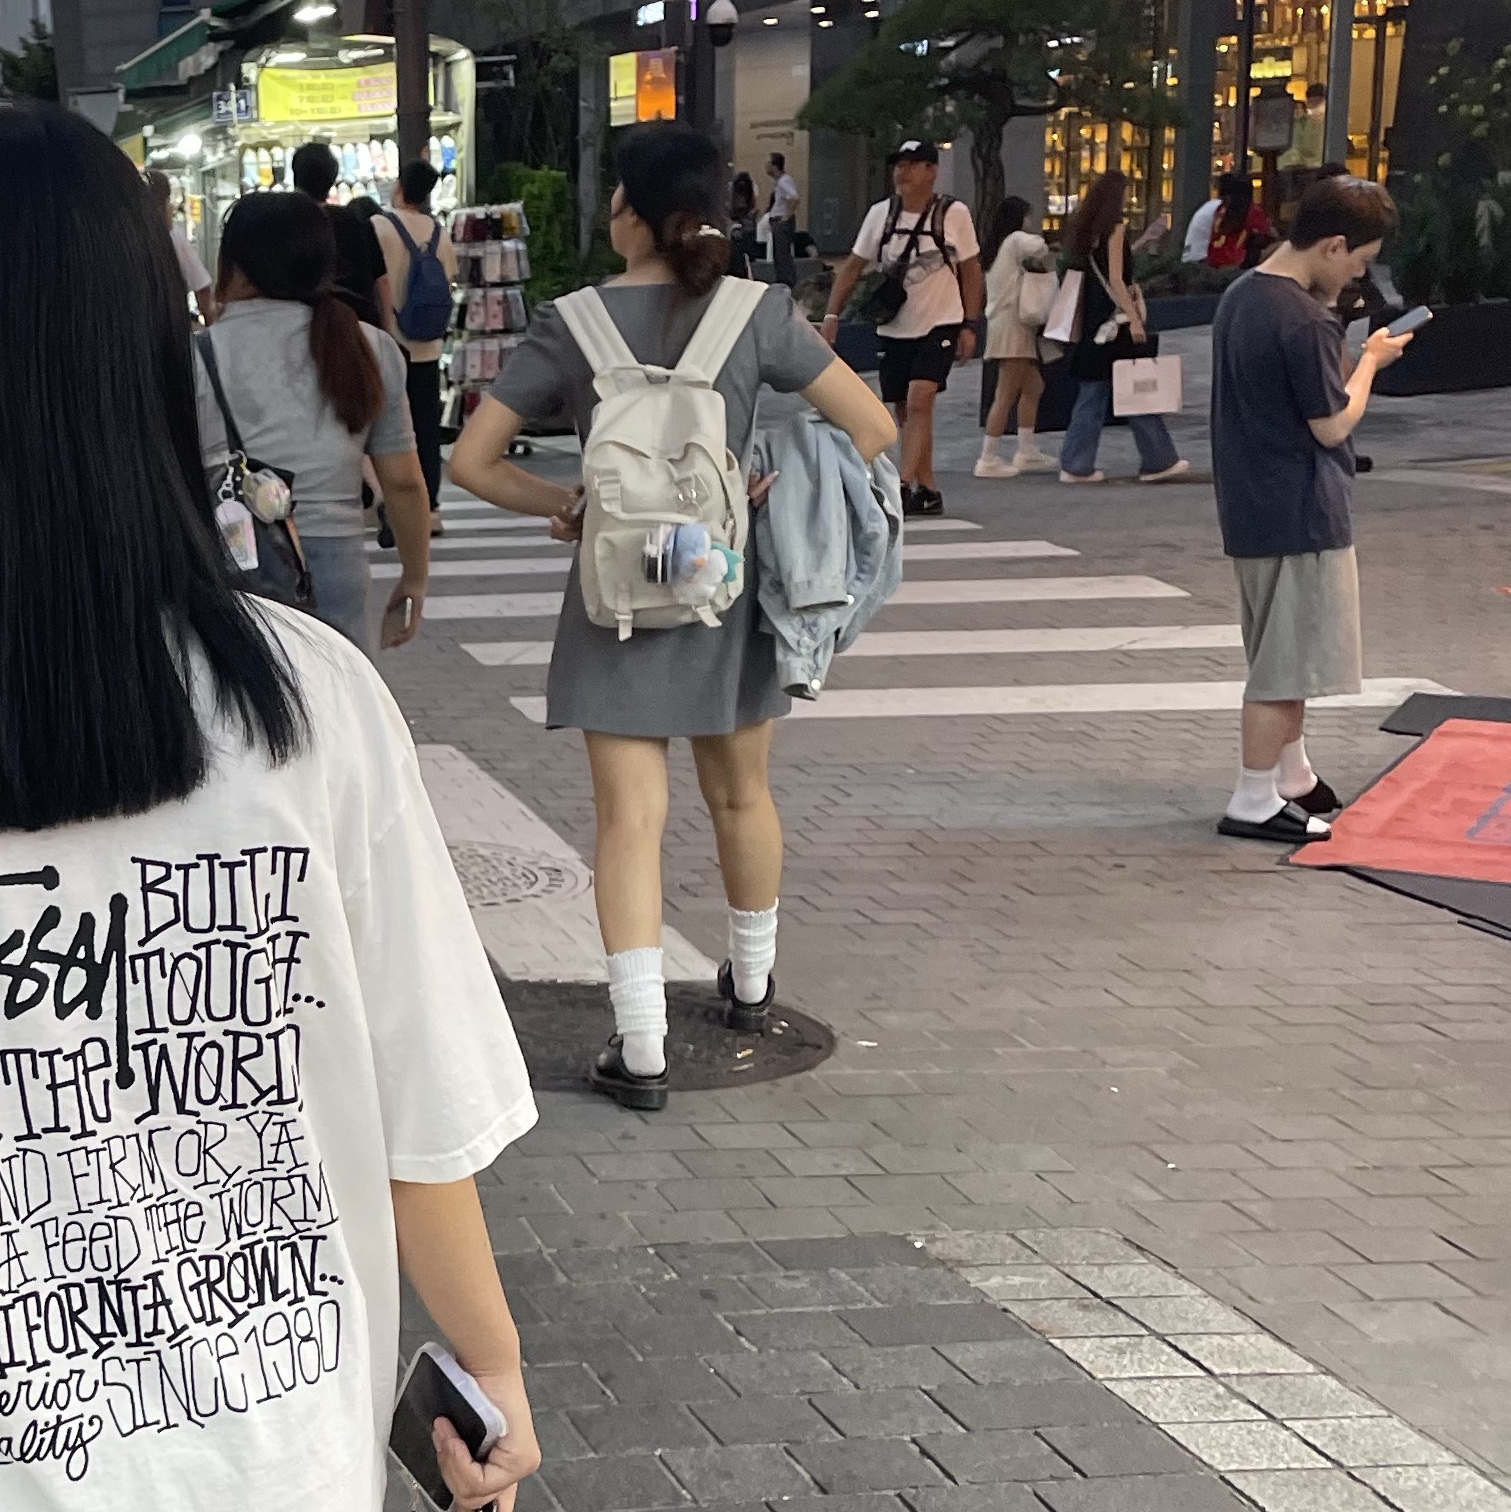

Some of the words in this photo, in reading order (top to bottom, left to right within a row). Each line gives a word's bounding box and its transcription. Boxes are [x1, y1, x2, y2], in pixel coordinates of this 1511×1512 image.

[130, 846, 310, 947] BUILT
[56, 1126, 179, 1215] FIRM
[174, 1120, 243, 1190] OR
[235, 1110, 308, 1175] YA
[208, 1160, 339, 1250] WORM
[244, 1300, 341, 1405] 1980
